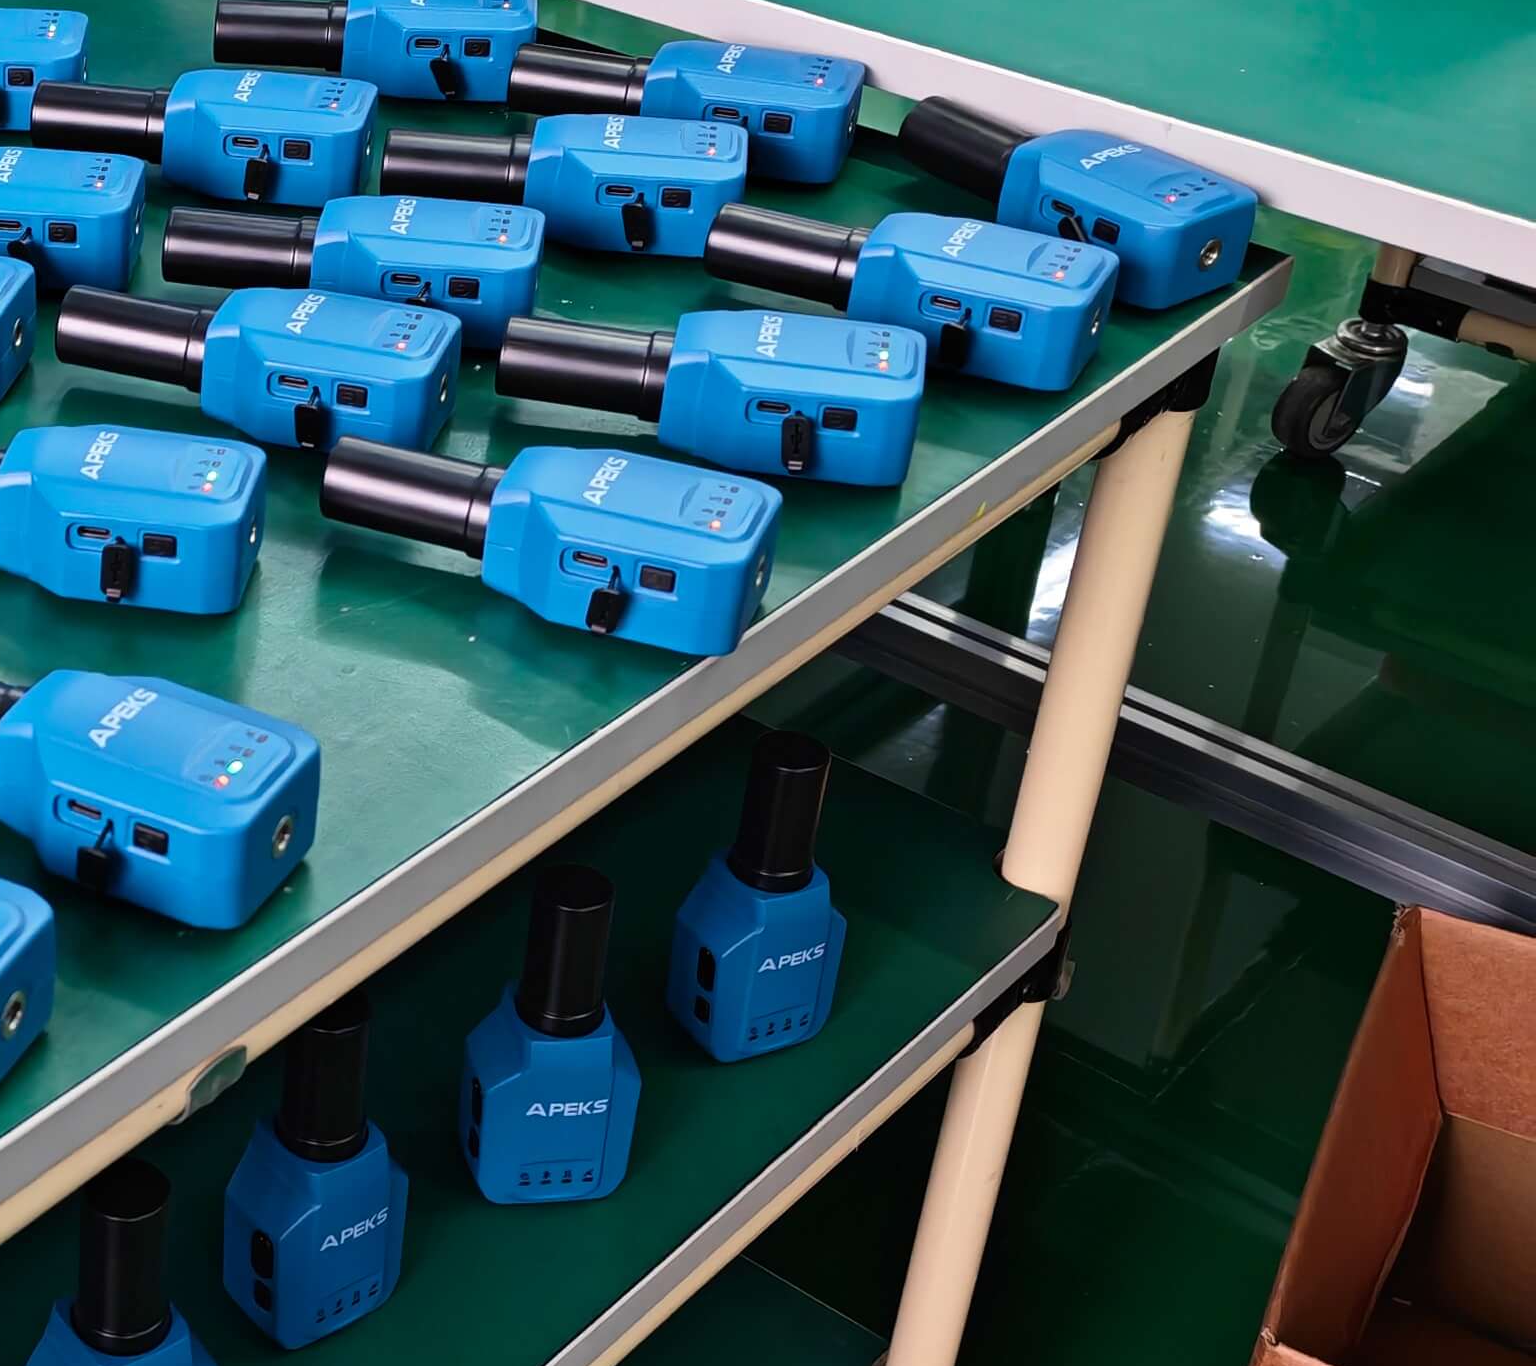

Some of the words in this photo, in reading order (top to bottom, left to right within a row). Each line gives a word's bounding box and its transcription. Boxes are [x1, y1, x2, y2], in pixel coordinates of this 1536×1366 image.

[716, 43, 746, 74] APEKS
[233, 70, 262, 103] APEKS
[603, 116, 625, 149] APEKS
[1079, 144, 1141, 170] APEKS
[389, 198, 417, 235] APEKS
[941, 221, 983, 258] APEKS
[285, 293, 327, 334] APEKS
[755, 315, 783, 358] APEKS
[80, 431, 119, 480] APEKS
[582, 456, 628, 506] APEKS
[88, 688, 158, 748] APEKS
[758, 942, 826, 973] APEKS
[527, 1099, 608, 1116] APEKS
[319, 1207, 389, 1252] APEKS
